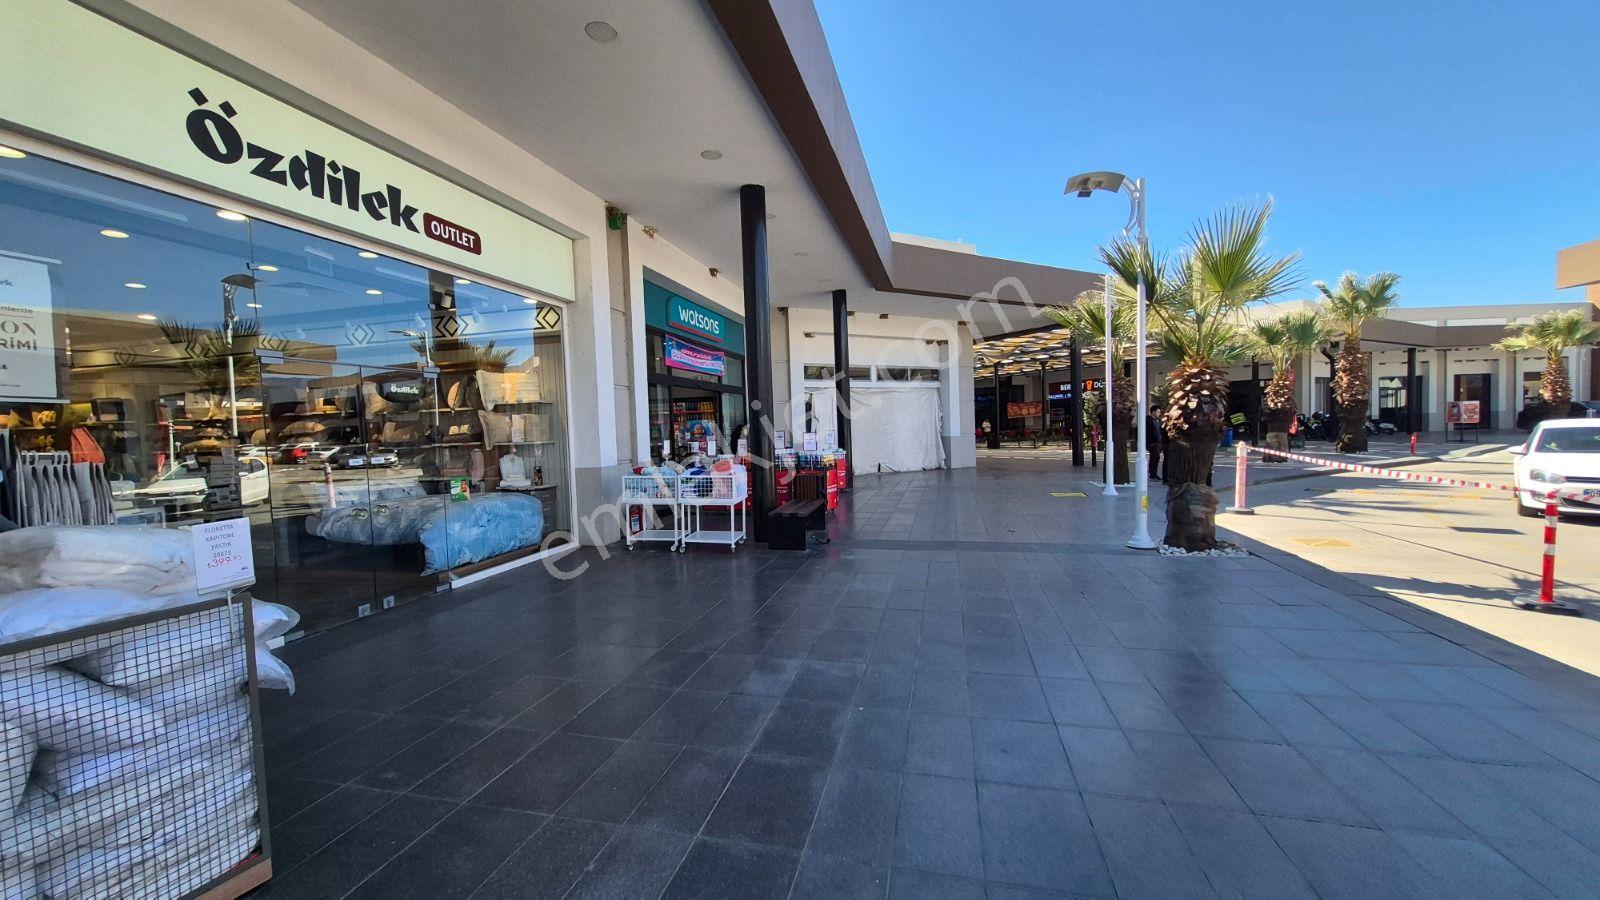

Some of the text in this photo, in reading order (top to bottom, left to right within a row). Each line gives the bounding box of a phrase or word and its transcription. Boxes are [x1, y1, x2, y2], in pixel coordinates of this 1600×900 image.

[186, 87, 475, 249] Özdilek OUTLET
[679, 305, 719, 334] watsons
[0, 336, 38, 351] RİMİ
